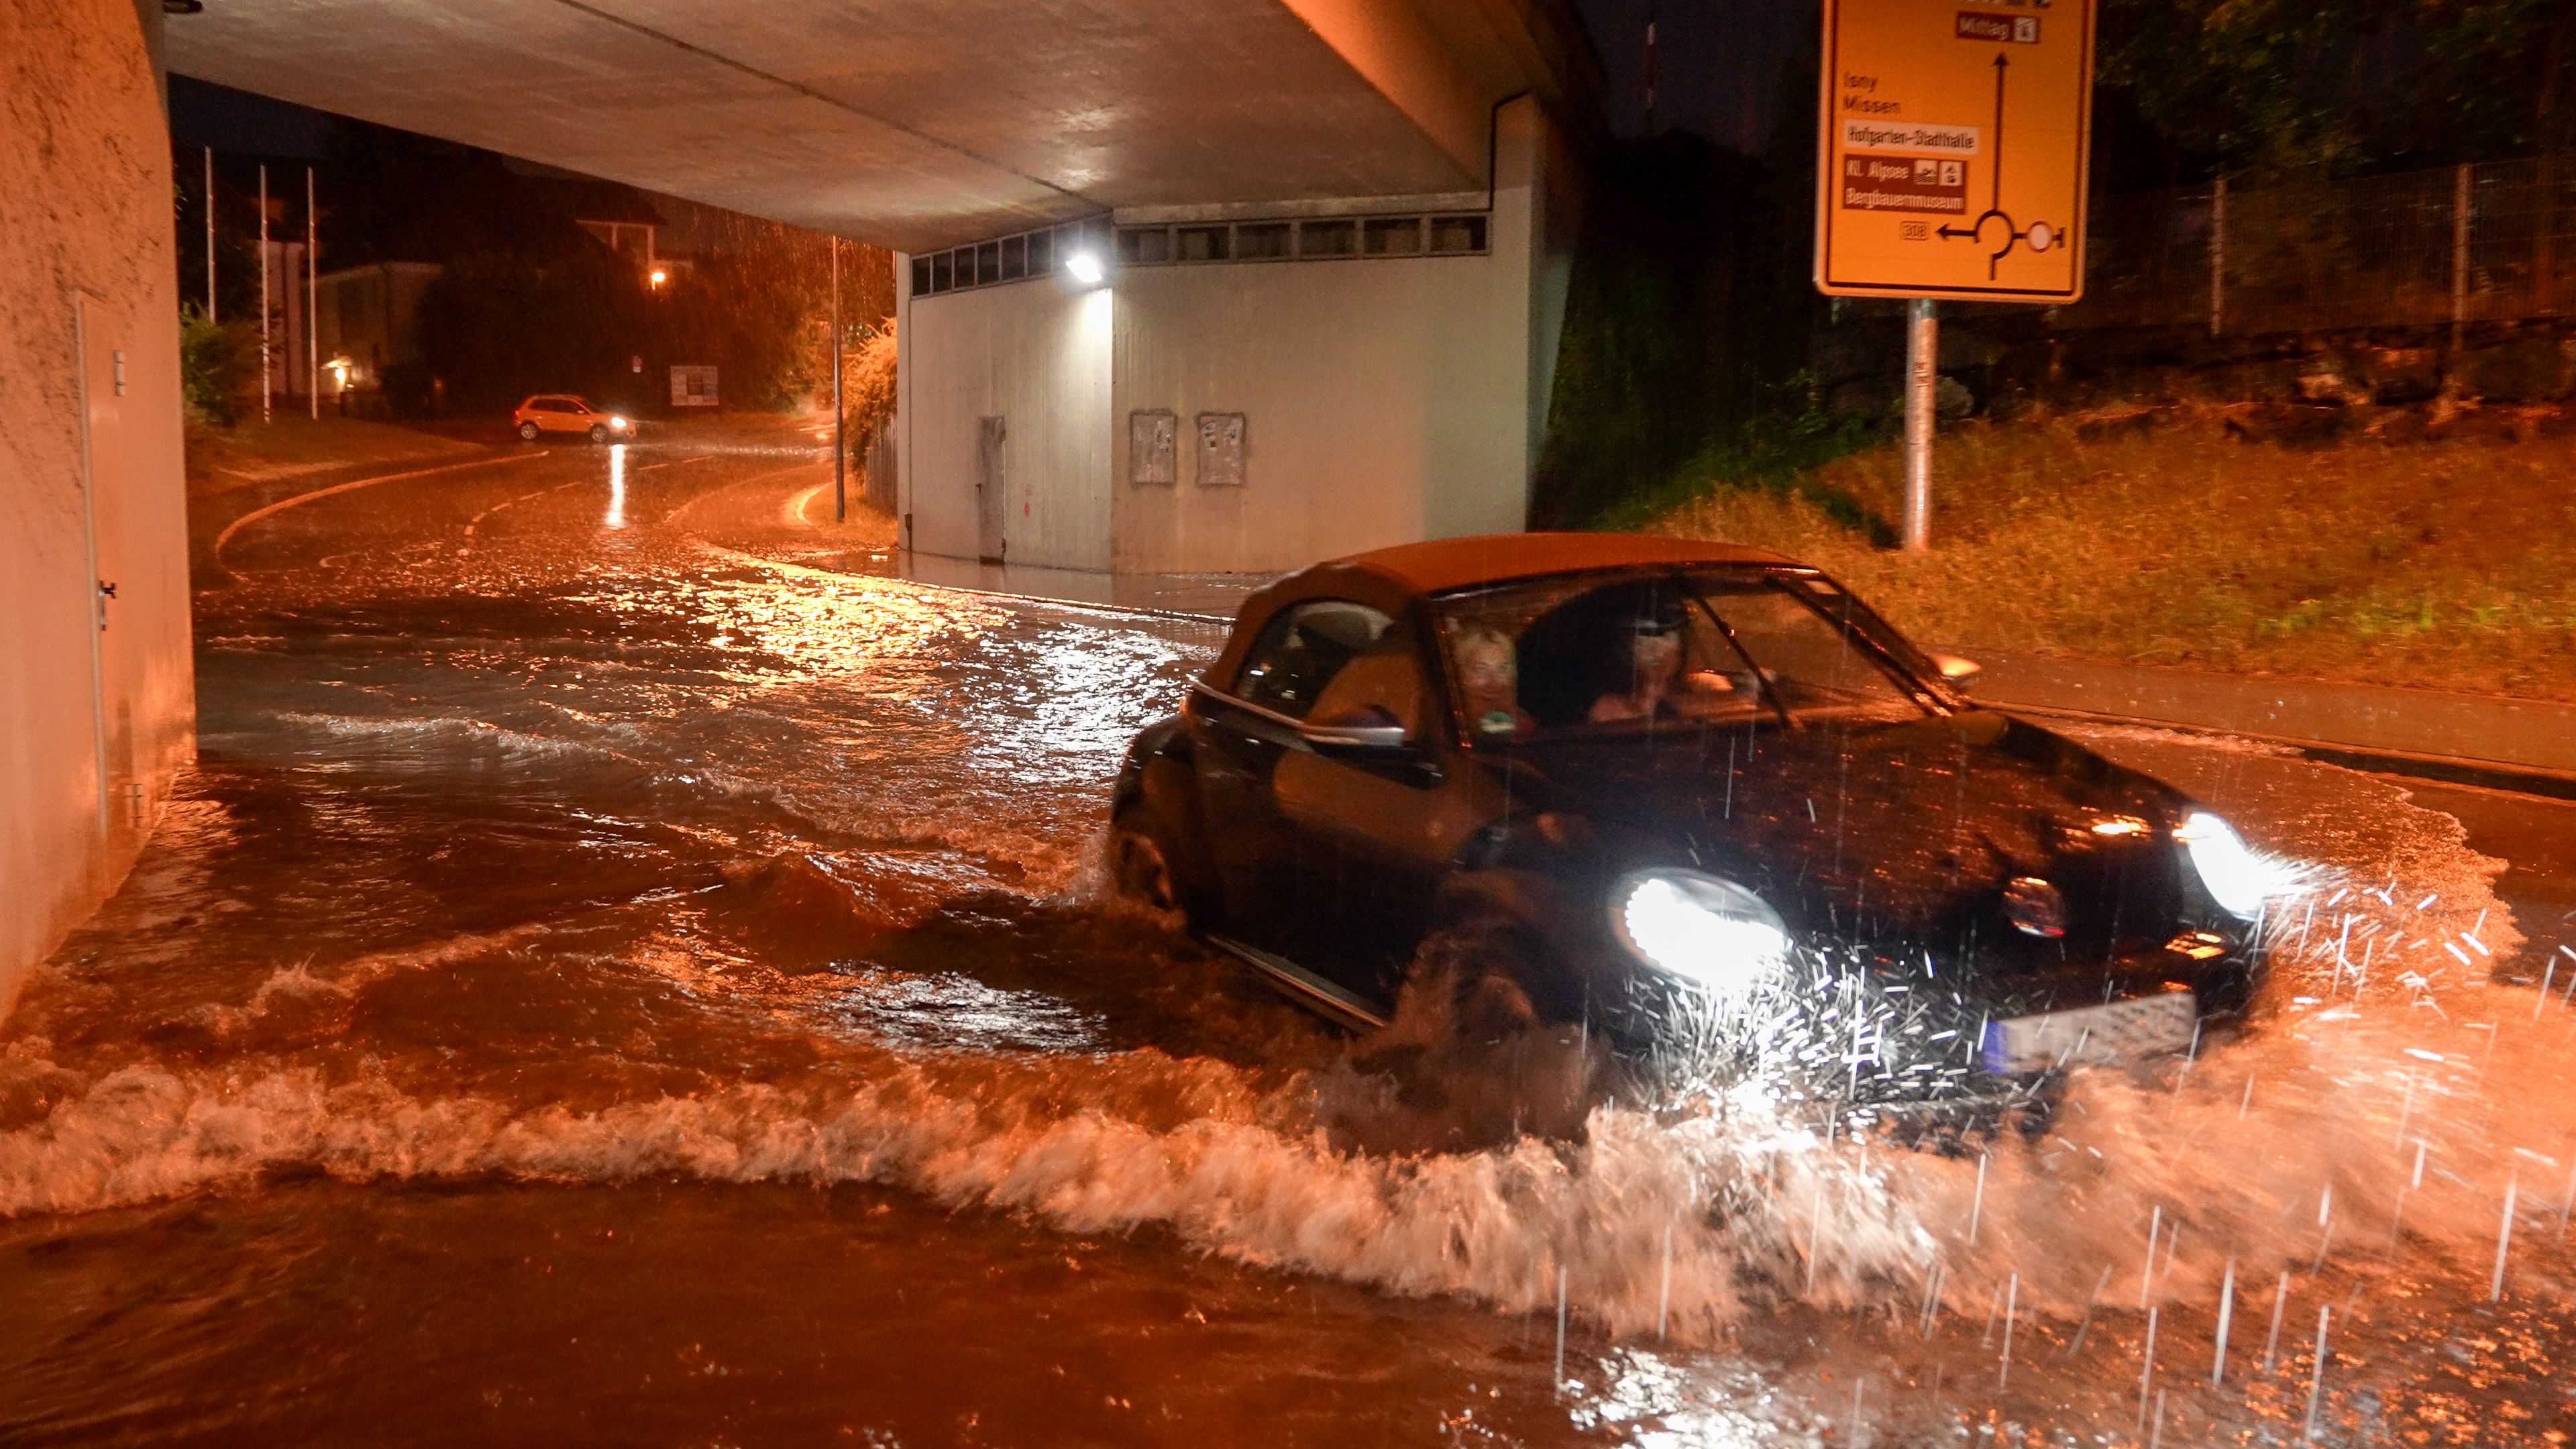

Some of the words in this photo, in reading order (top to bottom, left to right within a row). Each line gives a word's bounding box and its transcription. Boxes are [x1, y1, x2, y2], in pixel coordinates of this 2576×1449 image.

[1959, 15, 2010, 40] Mittag
[1844, 72, 1878, 93] Isny
[1843, 95, 1901, 114] Missen
[1847, 125, 1975, 149] Hofgarten-Stadthalle
[1867, 160, 1910, 182] Alpsee
[1846, 186, 1964, 209] Bergbauernmuseum
[1902, 224, 1927, 238] 308
